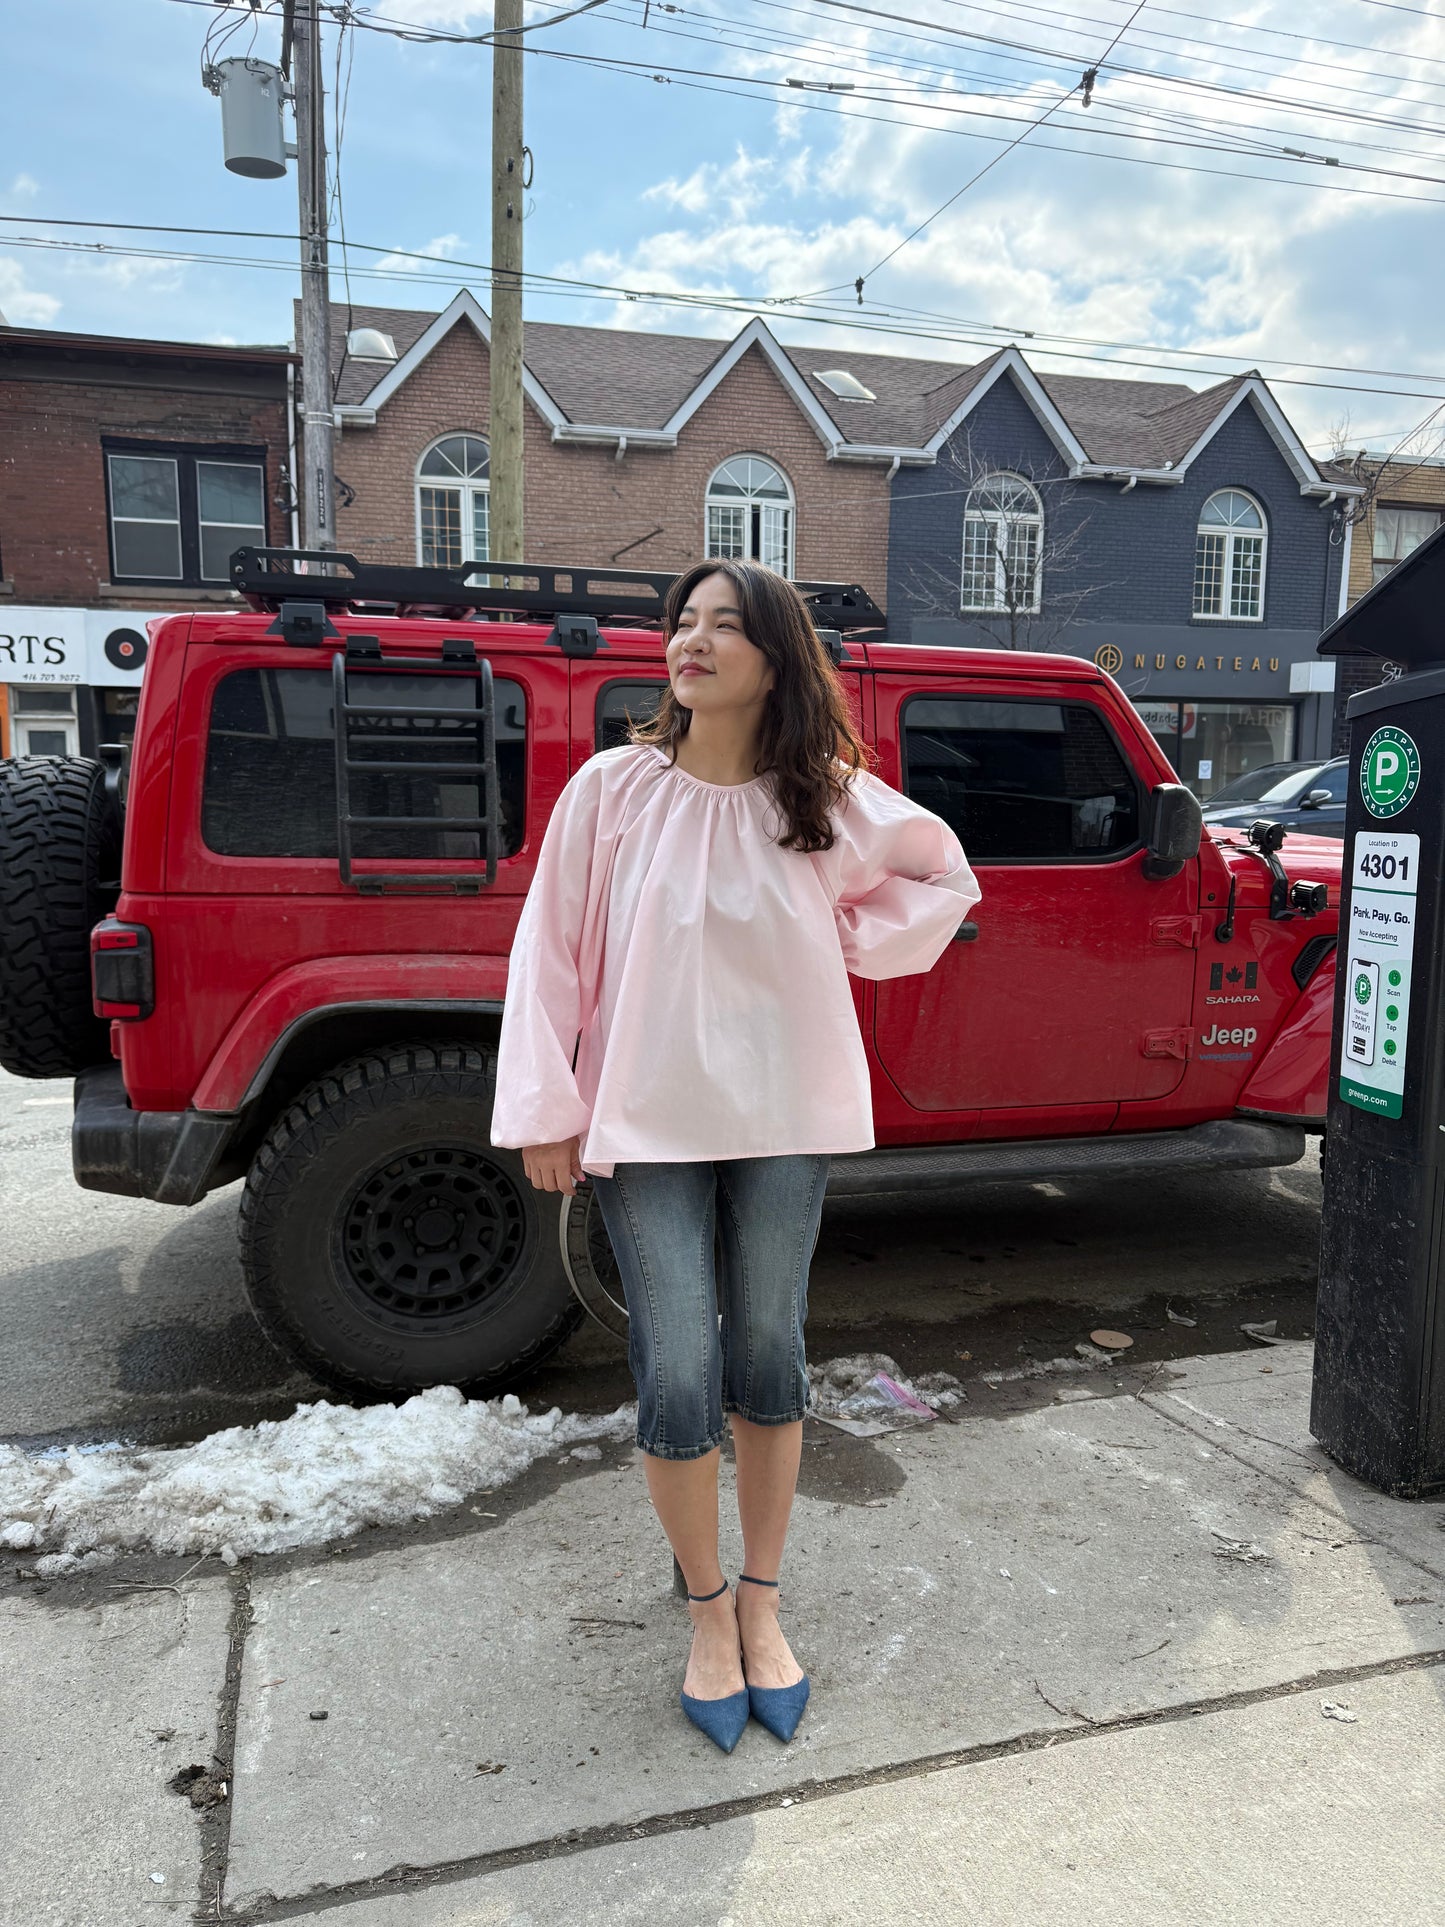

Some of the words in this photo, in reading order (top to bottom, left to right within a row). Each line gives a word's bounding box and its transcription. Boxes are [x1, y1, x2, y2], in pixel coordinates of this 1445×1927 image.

[1135, 654, 1279, 672] NUGATEAU
[1363, 731, 1417, 770] MUNICIPAL
[1375, 751, 1399, 786] P
[1362, 780, 1416, 815] PARKING
[1368, 839, 1390, 847] Location
[1391, 840, 1398, 848] ID
[1360, 853, 1409, 881] 4301
[1353, 905, 1371, 920] Park.
[1372, 909, 1392, 925] Pay.
[1394, 912, 1411, 925] Go.
[1369, 930, 1398, 942] Accepting
[1206, 995, 1261, 1005] SAHARA
[1386, 988, 1401, 997] Scan
[1202, 1024, 1257, 1048] Jeep
[1351, 1020, 1371, 1034] TODAY!
[1386, 1023, 1397, 1033] Tap
[1381, 1057, 1397, 1067] Debit
[1348, 1088, 1388, 1107] greenp.com
